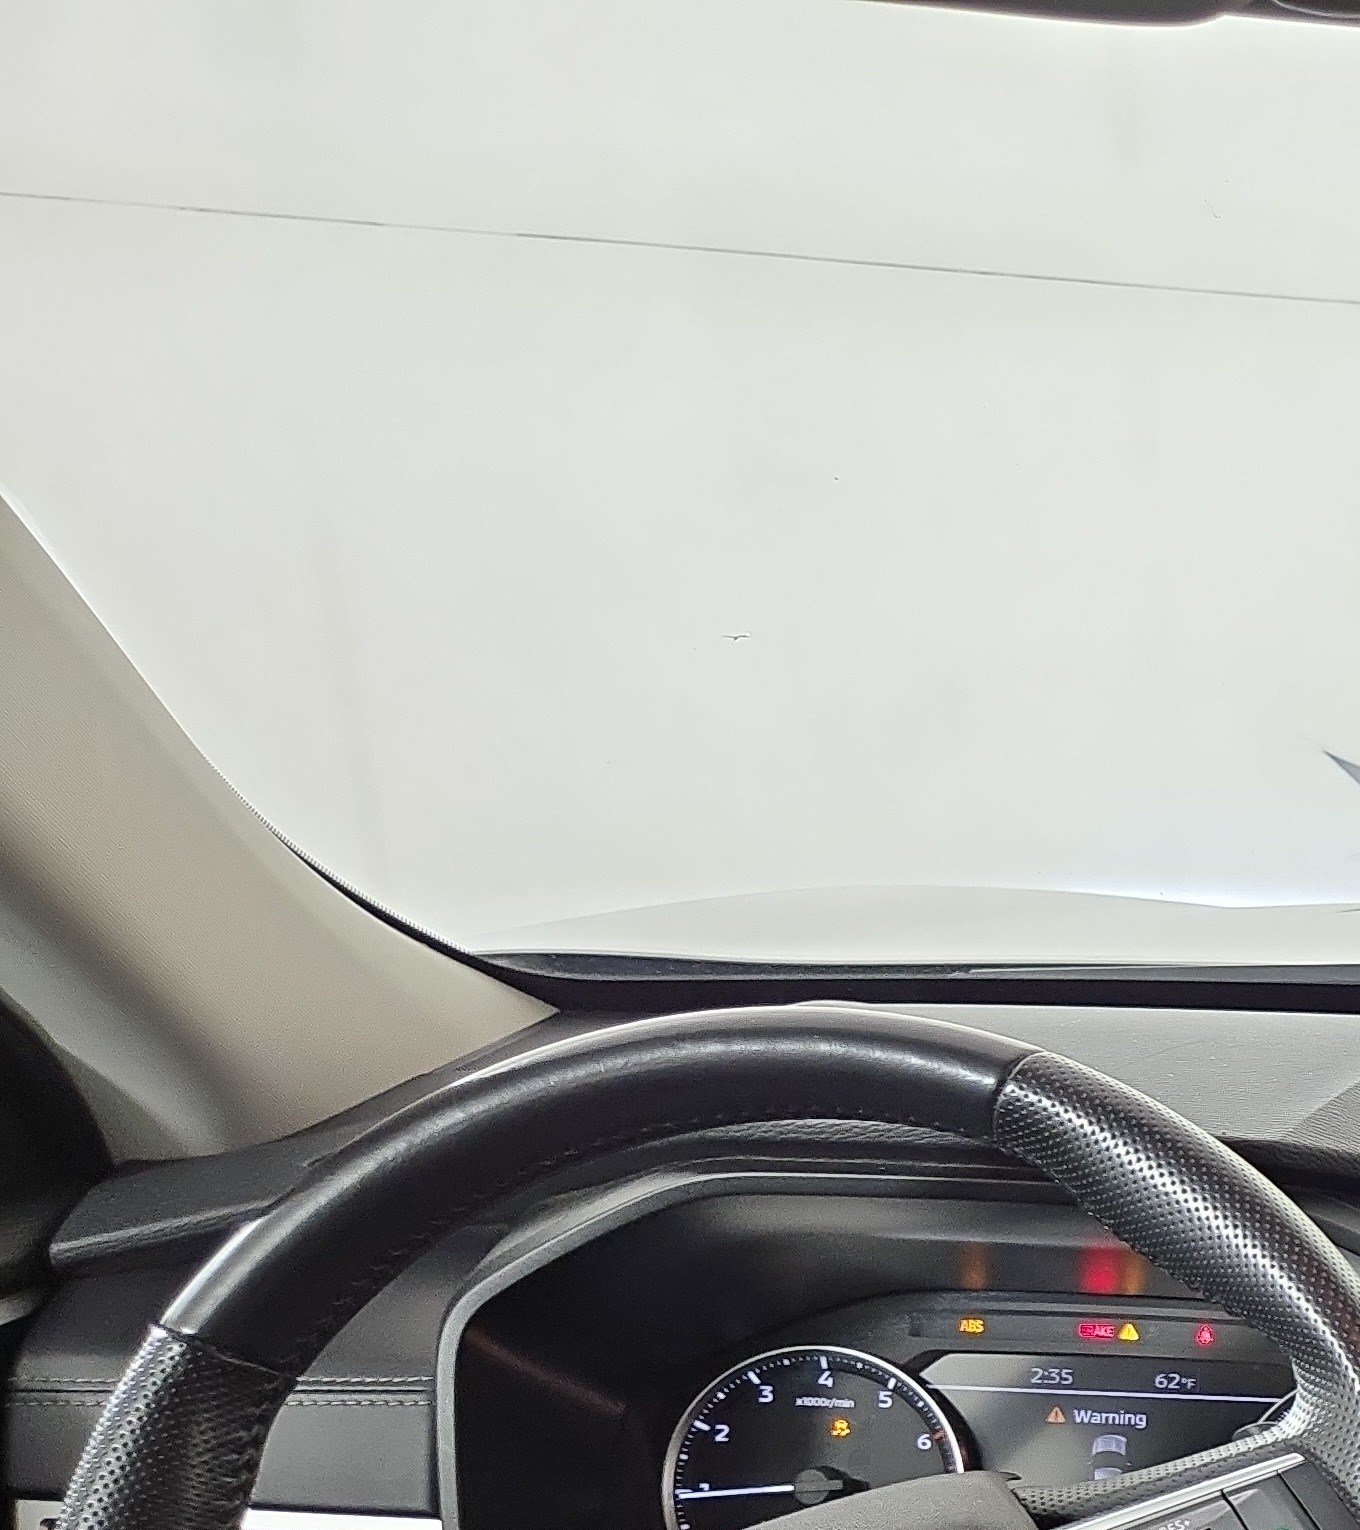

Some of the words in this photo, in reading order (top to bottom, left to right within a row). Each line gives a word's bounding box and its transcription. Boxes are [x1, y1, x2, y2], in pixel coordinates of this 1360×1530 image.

[959, 1318, 985, 1333] ABS
[817, 1369, 834, 1388] 4
[1029, 1367, 1075, 1385] 2:35
[757, 1385, 774, 1404] 3
[877, 1390, 894, 1409] 5
[1072, 1408, 1148, 1429] Warning
[714, 1424, 730, 1443] 2
[916, 1433, 933, 1451] 6
